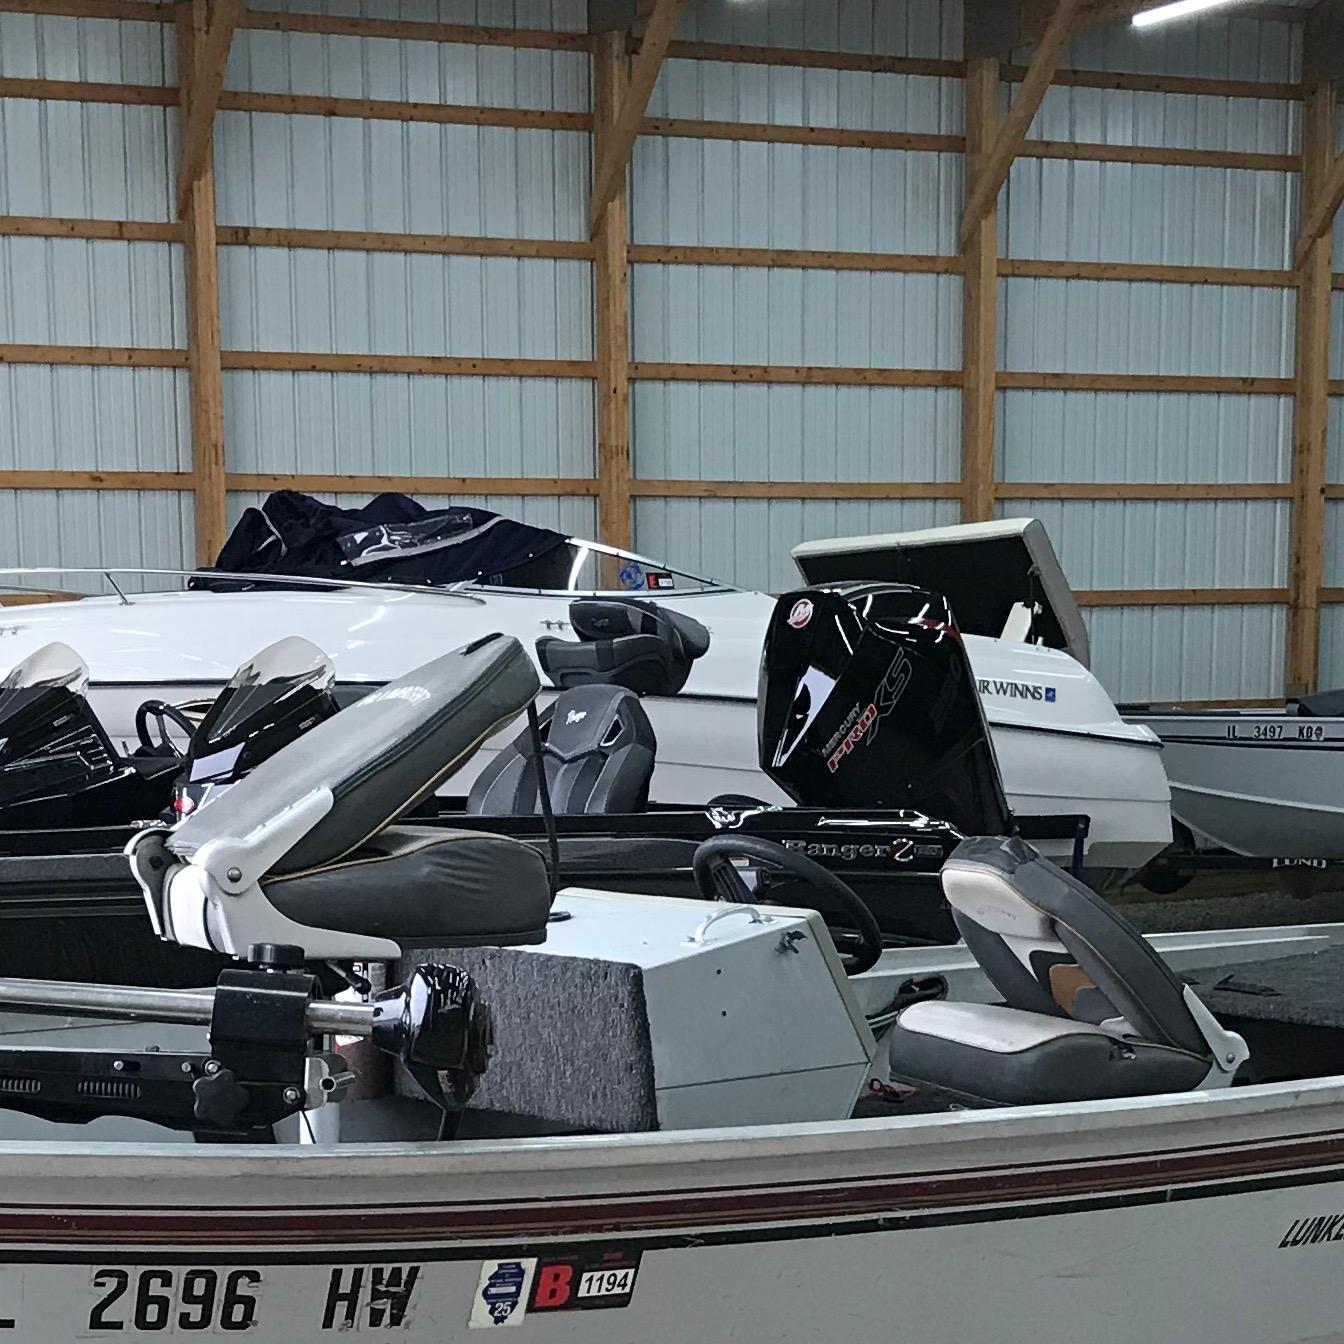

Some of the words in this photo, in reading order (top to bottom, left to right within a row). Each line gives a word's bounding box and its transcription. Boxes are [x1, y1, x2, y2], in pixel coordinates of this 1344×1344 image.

[993, 680, 1043, 701] WINNS
[1227, 725, 1239, 739] IL
[1254, 724, 1284, 740] 3497
[1272, 858, 1327, 869] LUND
[533, 1263, 573, 1308] B
[583, 1271, 630, 1295] 1194
[88, 1268, 262, 1331] 2696
[321, 1265, 421, 1330] HW
[493, 1301, 512, 1317] 25
